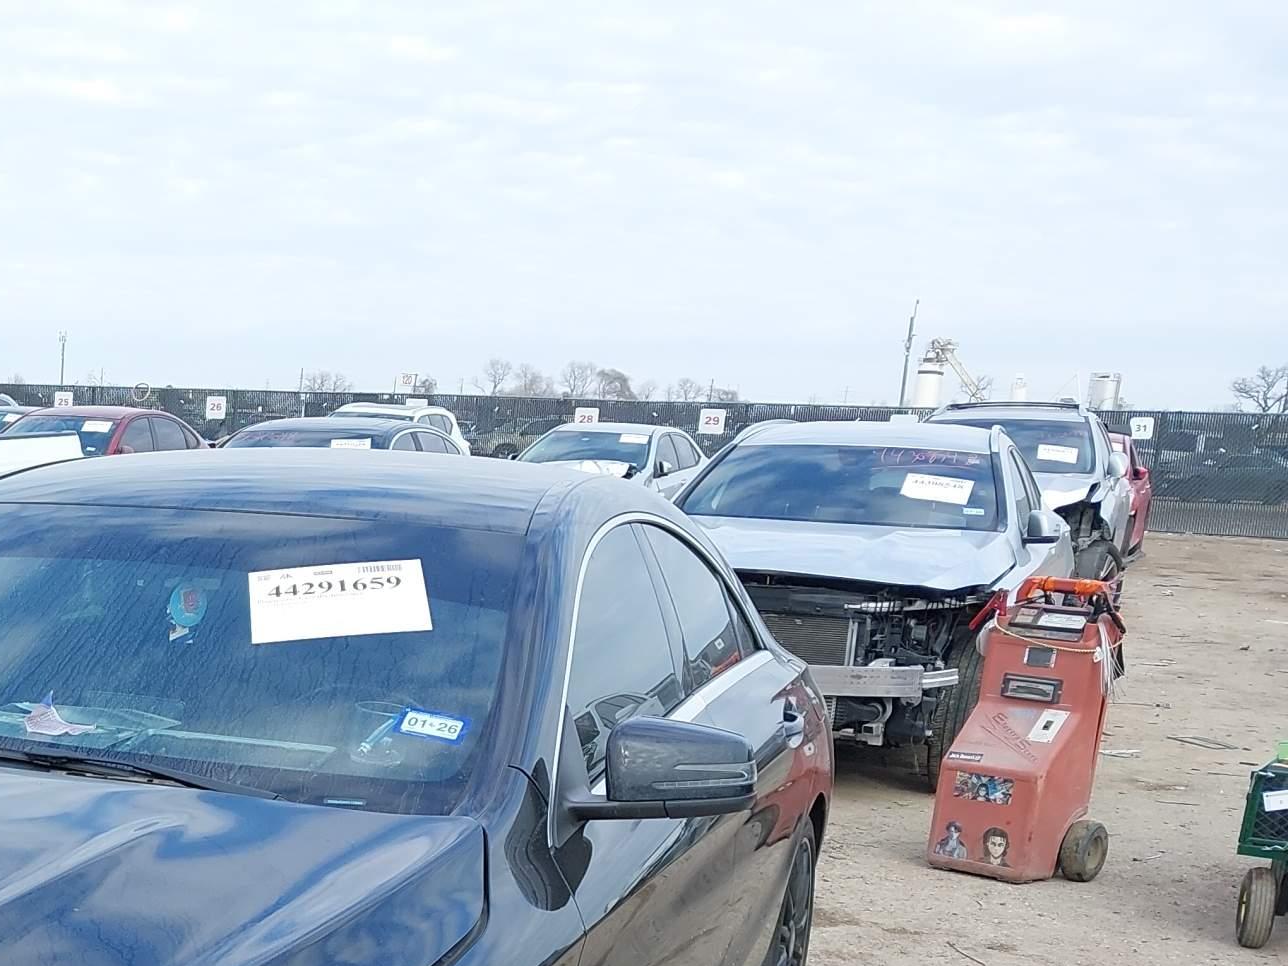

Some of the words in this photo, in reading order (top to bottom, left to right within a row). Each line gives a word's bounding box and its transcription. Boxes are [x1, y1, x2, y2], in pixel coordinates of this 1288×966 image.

[57, 398, 70, 406] 25
[209, 402, 223, 412] 26
[578, 414, 594, 424] 28
[703, 416, 720, 426] 29
[1135, 424, 1148, 432] 31
[267, 574, 402, 598] 44291659
